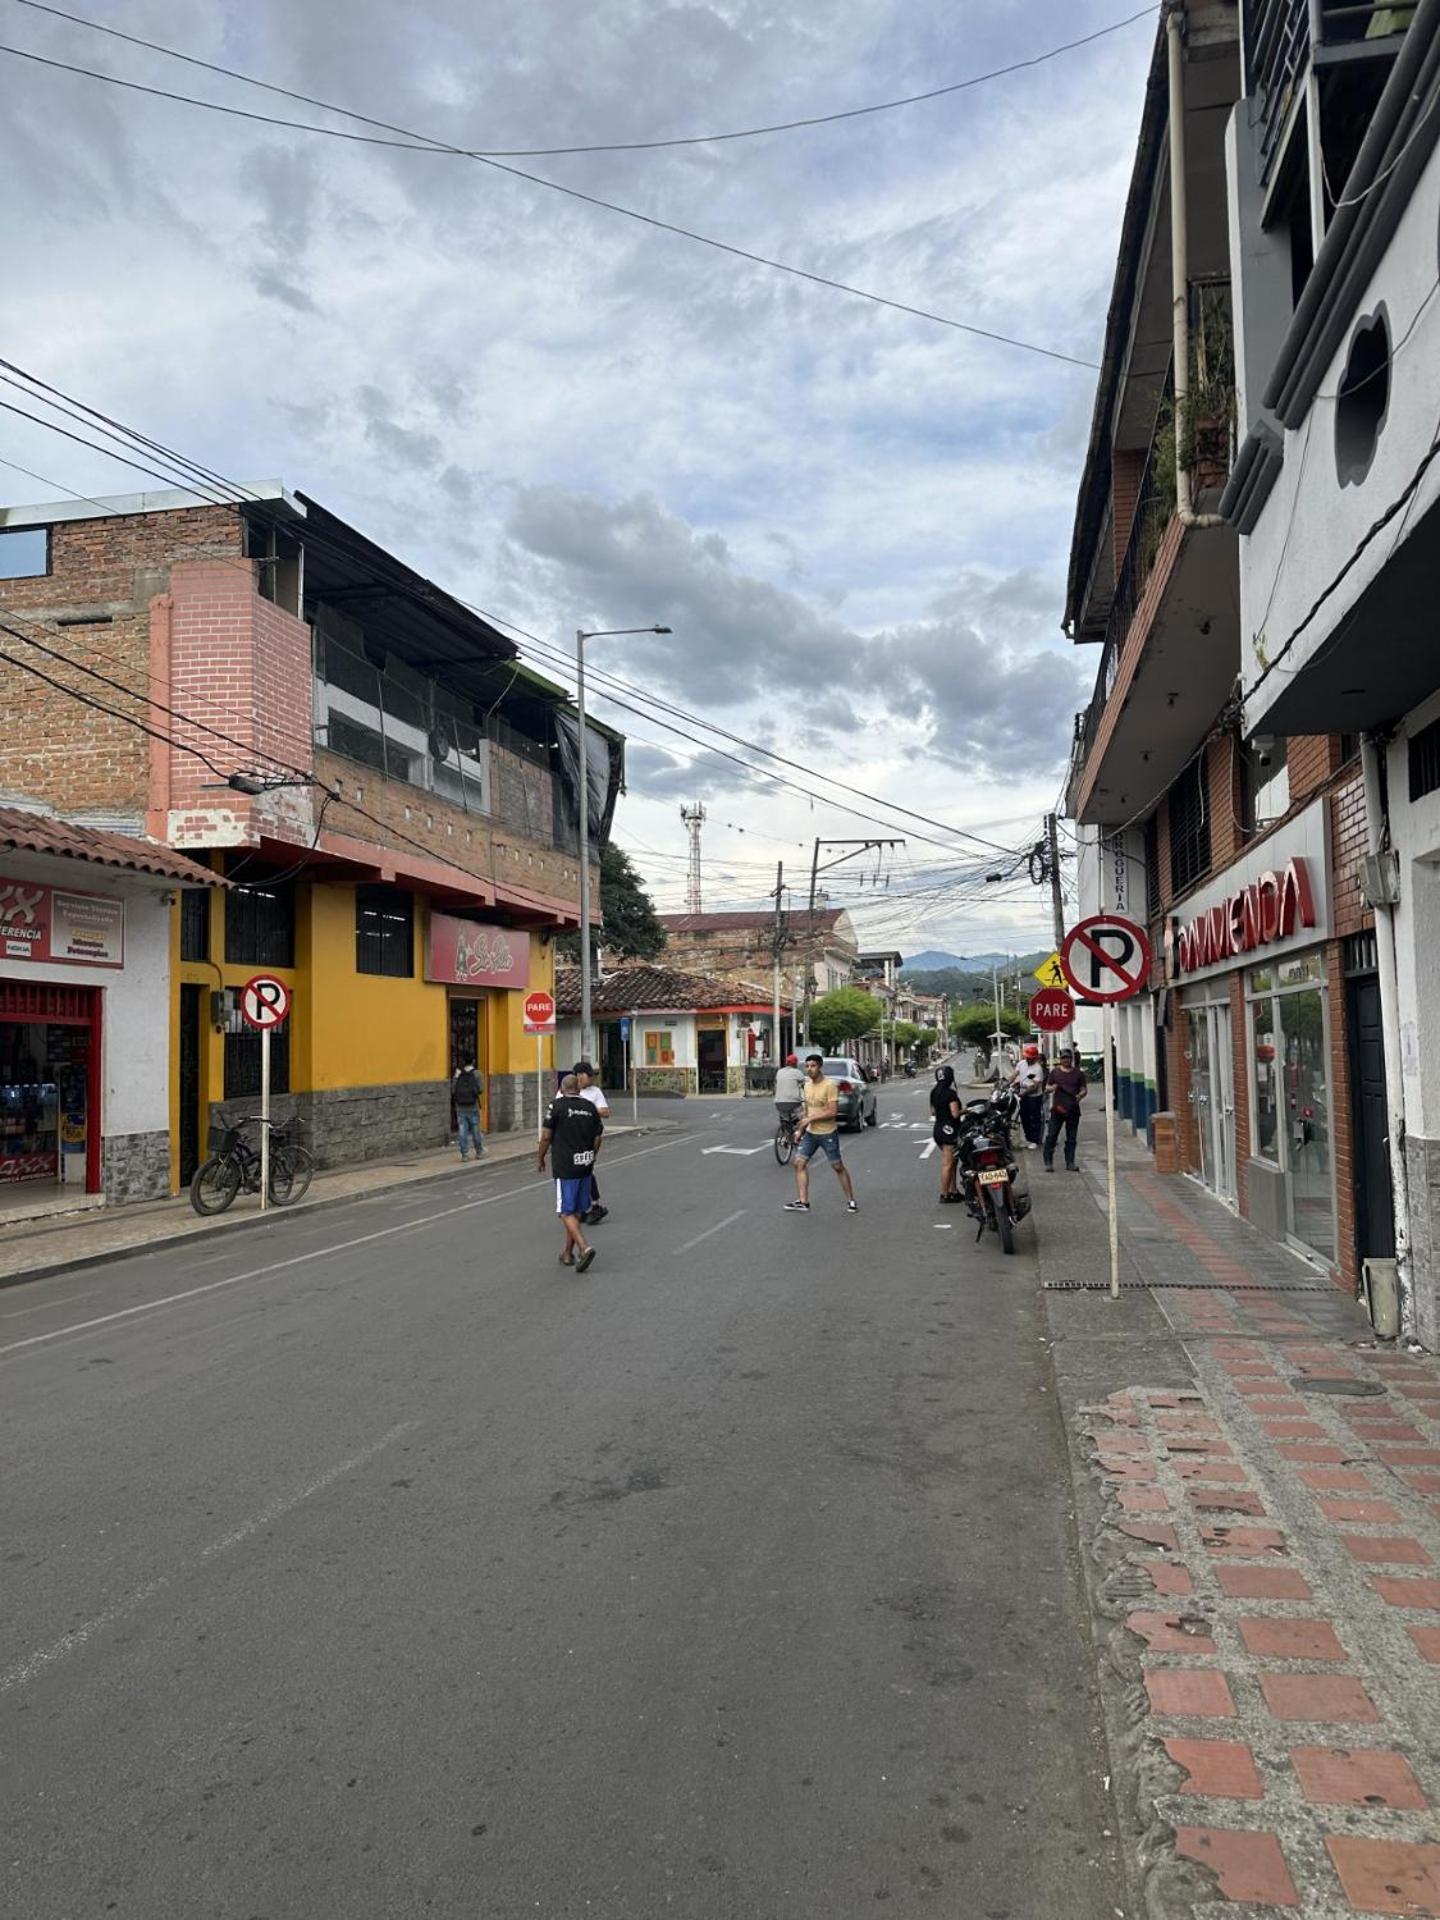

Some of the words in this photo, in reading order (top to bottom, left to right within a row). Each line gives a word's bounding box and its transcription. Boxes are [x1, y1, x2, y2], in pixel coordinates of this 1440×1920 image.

[1178, 856, 1316, 973] DAVIVIENDA
[1091, 929, 1135, 988] P
[256, 983, 281, 1020] P
[527, 1002, 552, 1013] PARE
[1036, 1003, 1069, 1018] PARE
